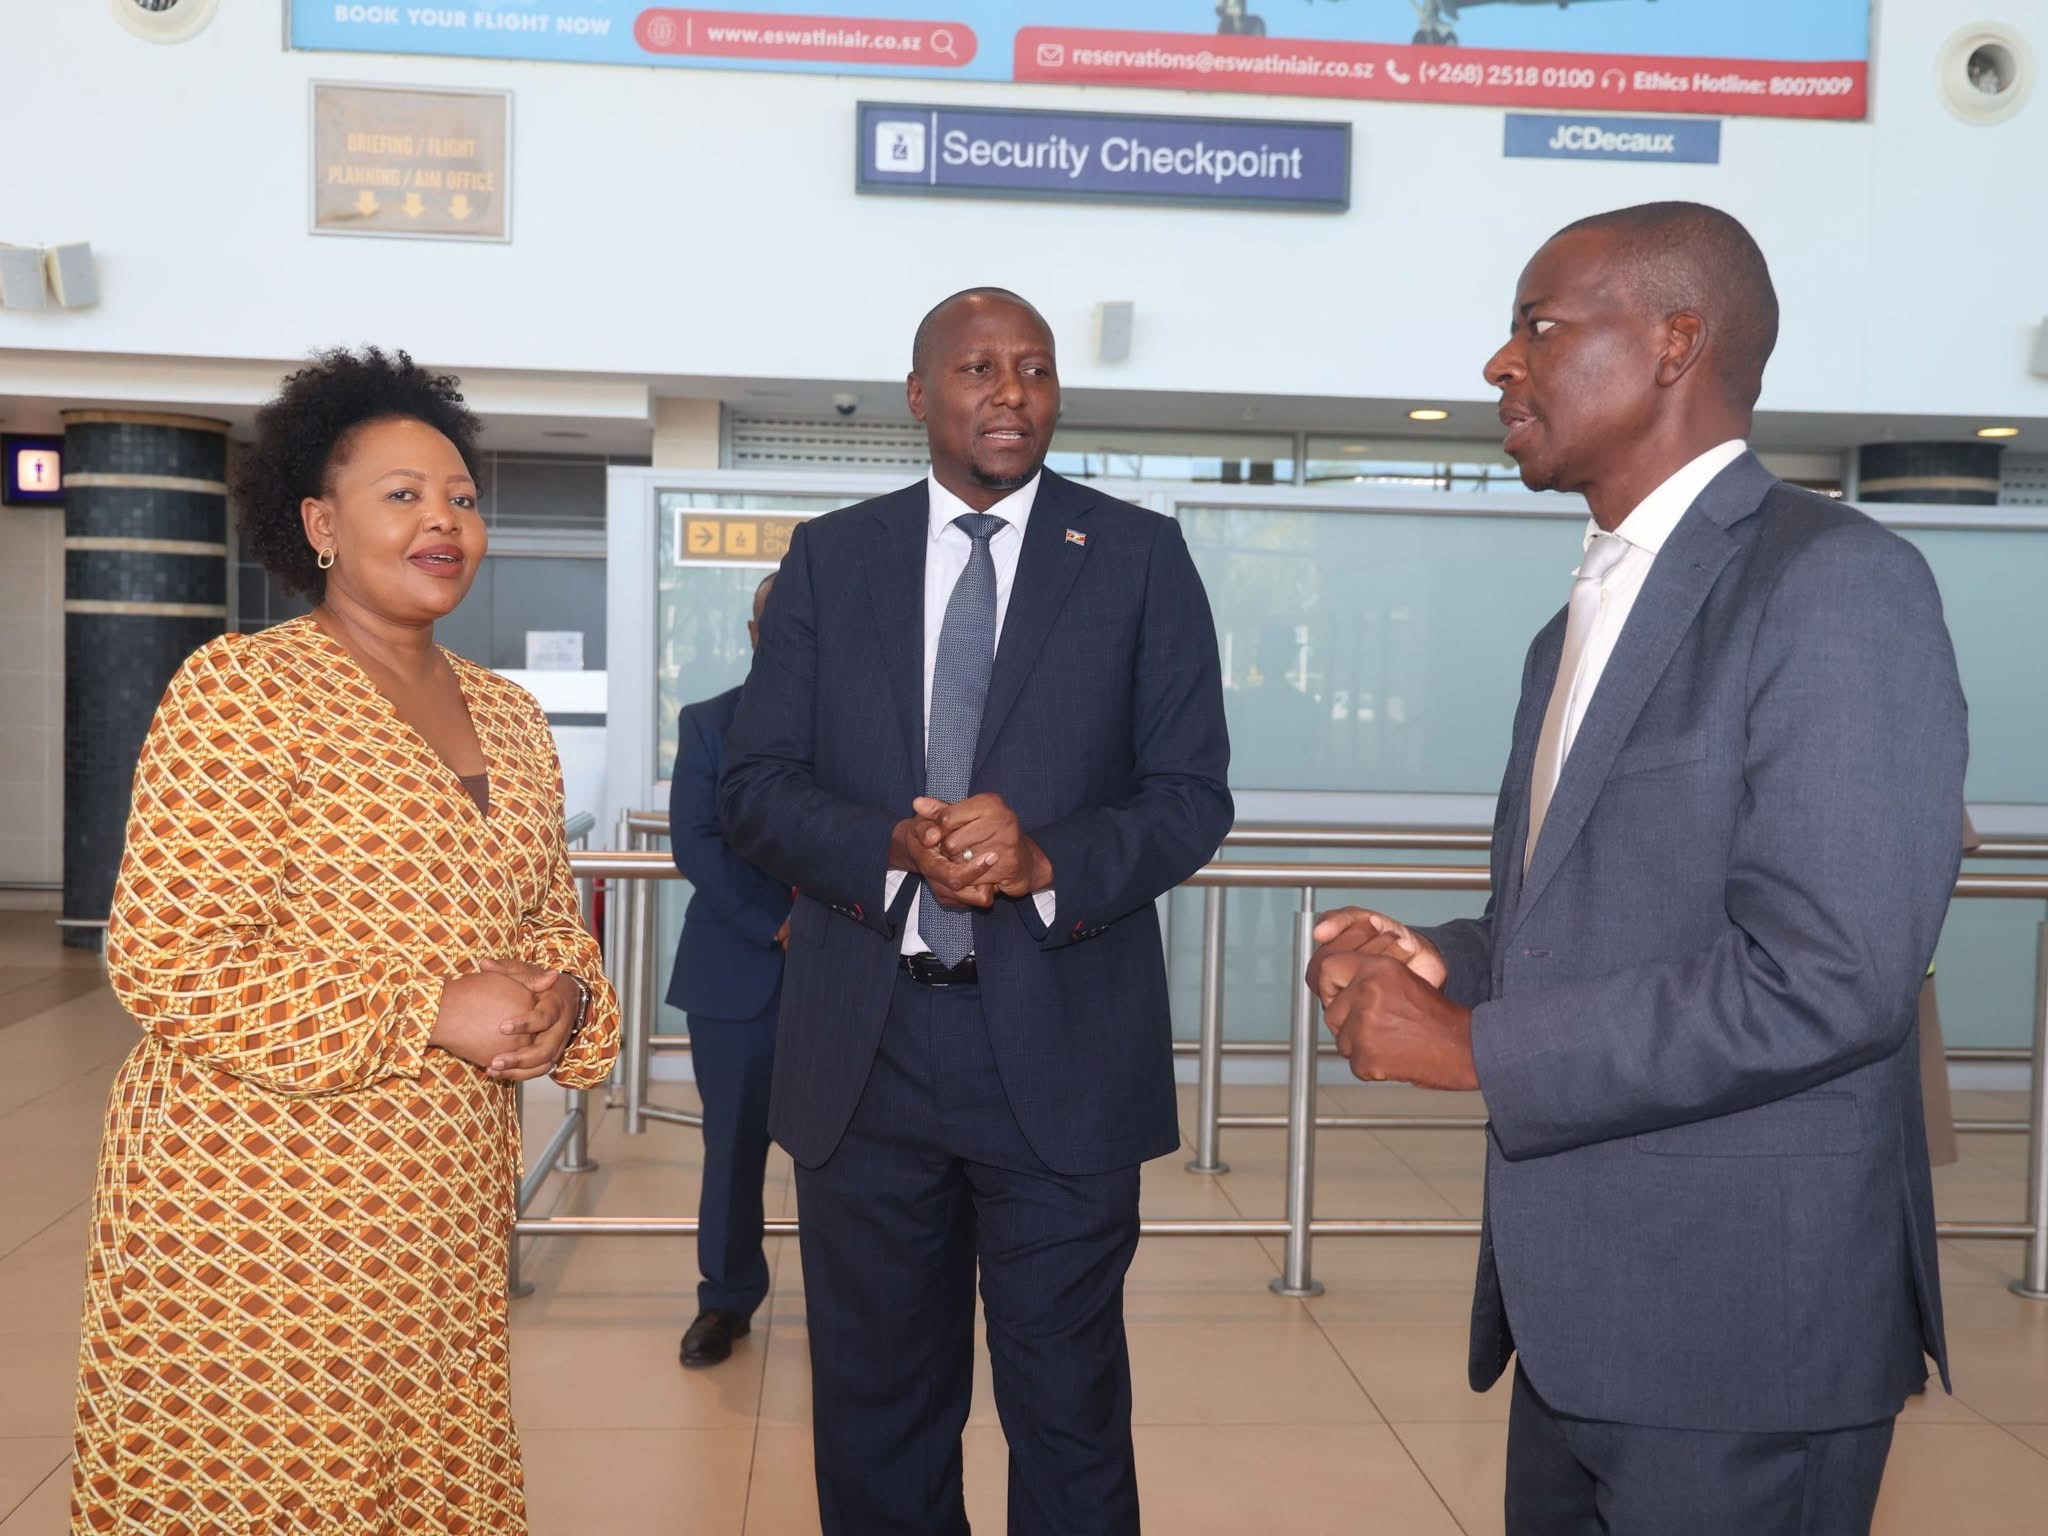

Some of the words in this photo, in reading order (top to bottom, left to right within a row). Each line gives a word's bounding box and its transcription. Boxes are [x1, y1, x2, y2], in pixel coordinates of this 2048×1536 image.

[334, 4, 398, 24] BOOK
[407, 8, 466, 28] YOUR
[474, 12, 549, 32] FLIGHT
[557, 17, 610, 35] NOW
[707, 25, 921, 51] www.eswatiniair.co.sz
[1072, 47, 1375, 79] reservations@eswatiniair.co.sz
[1418, 61, 1482, 86] (+268)
[1487, 64, 1539, 86] 2518
[1543, 67, 1595, 89] 0100
[1633, 71, 1688, 92] Ethics
[1692, 71, 1766, 94] Hotline:
[1770, 74, 1853, 96] 8007009
[347, 133, 412, 156] BRIEFING
[428, 138, 477, 157] FLIGHT
[1549, 125, 1675, 153] JCDecaux
[942, 130, 1089, 179] Security
[1101, 137, 1302, 184] Checkpoint
[328, 164, 401, 186] PLANNING
[446, 170, 495, 191] OFFICE
